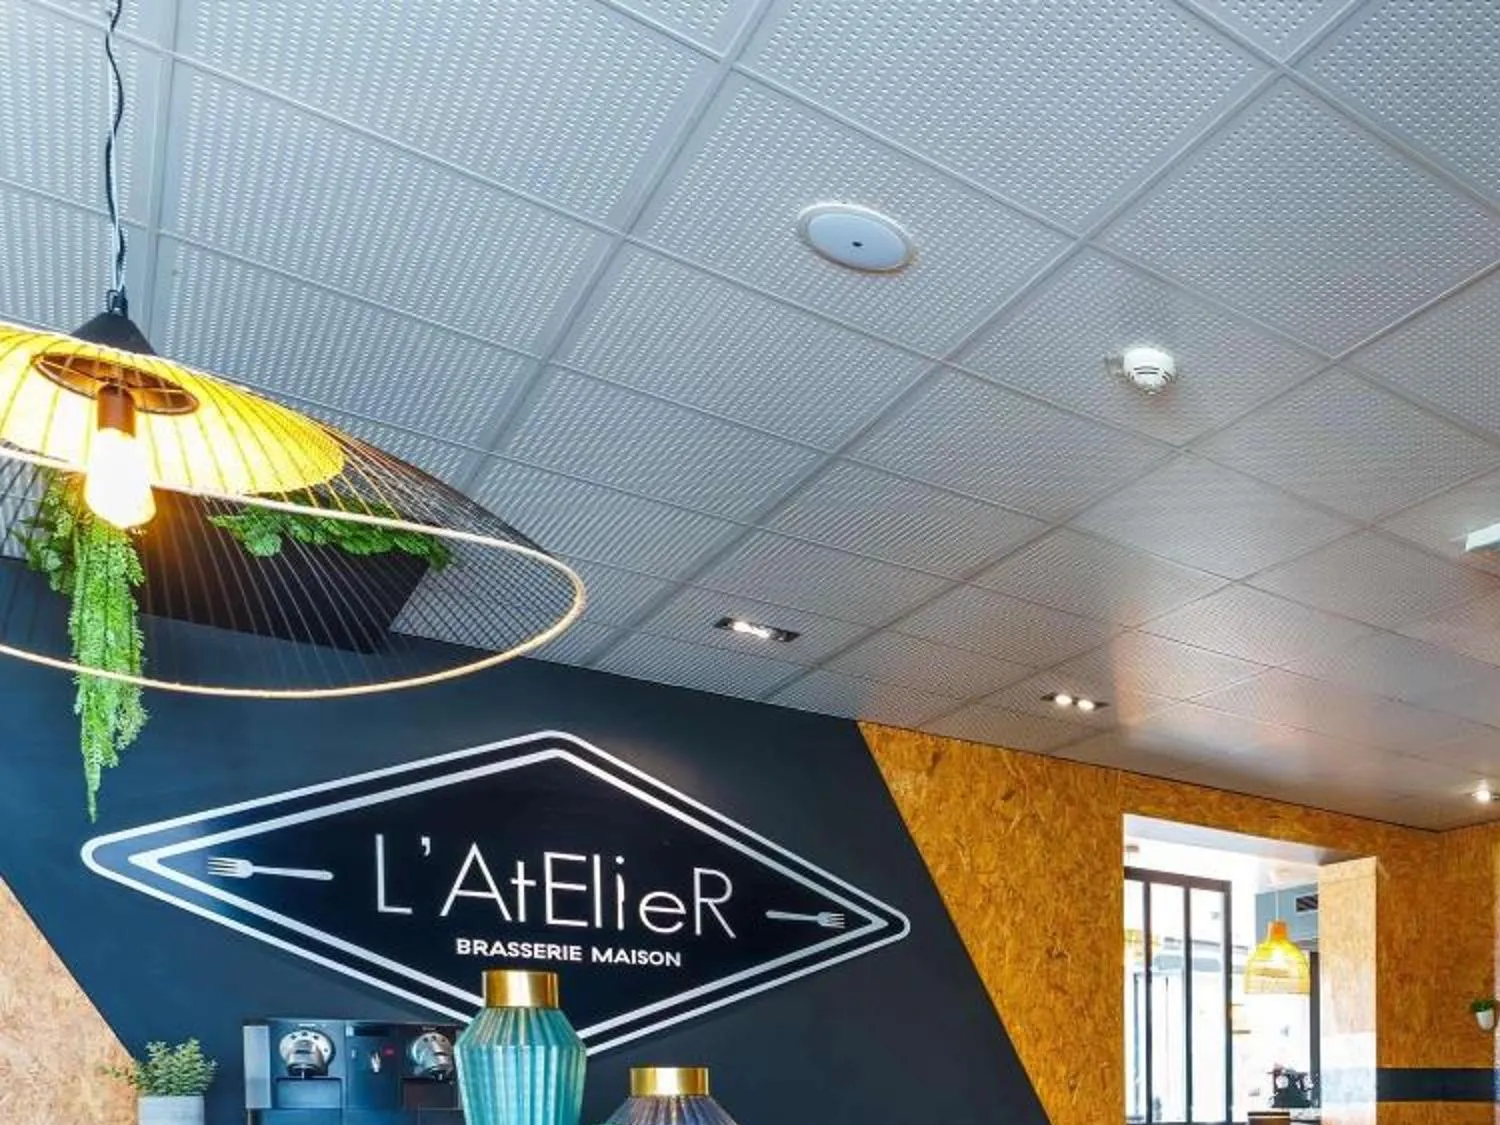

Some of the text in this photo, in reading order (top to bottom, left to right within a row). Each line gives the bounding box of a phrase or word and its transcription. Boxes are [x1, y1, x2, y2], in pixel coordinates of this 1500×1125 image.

[375, 833, 737, 939] L'AtElieR
[455, 938, 682, 968] BRASSERIE MAISON
